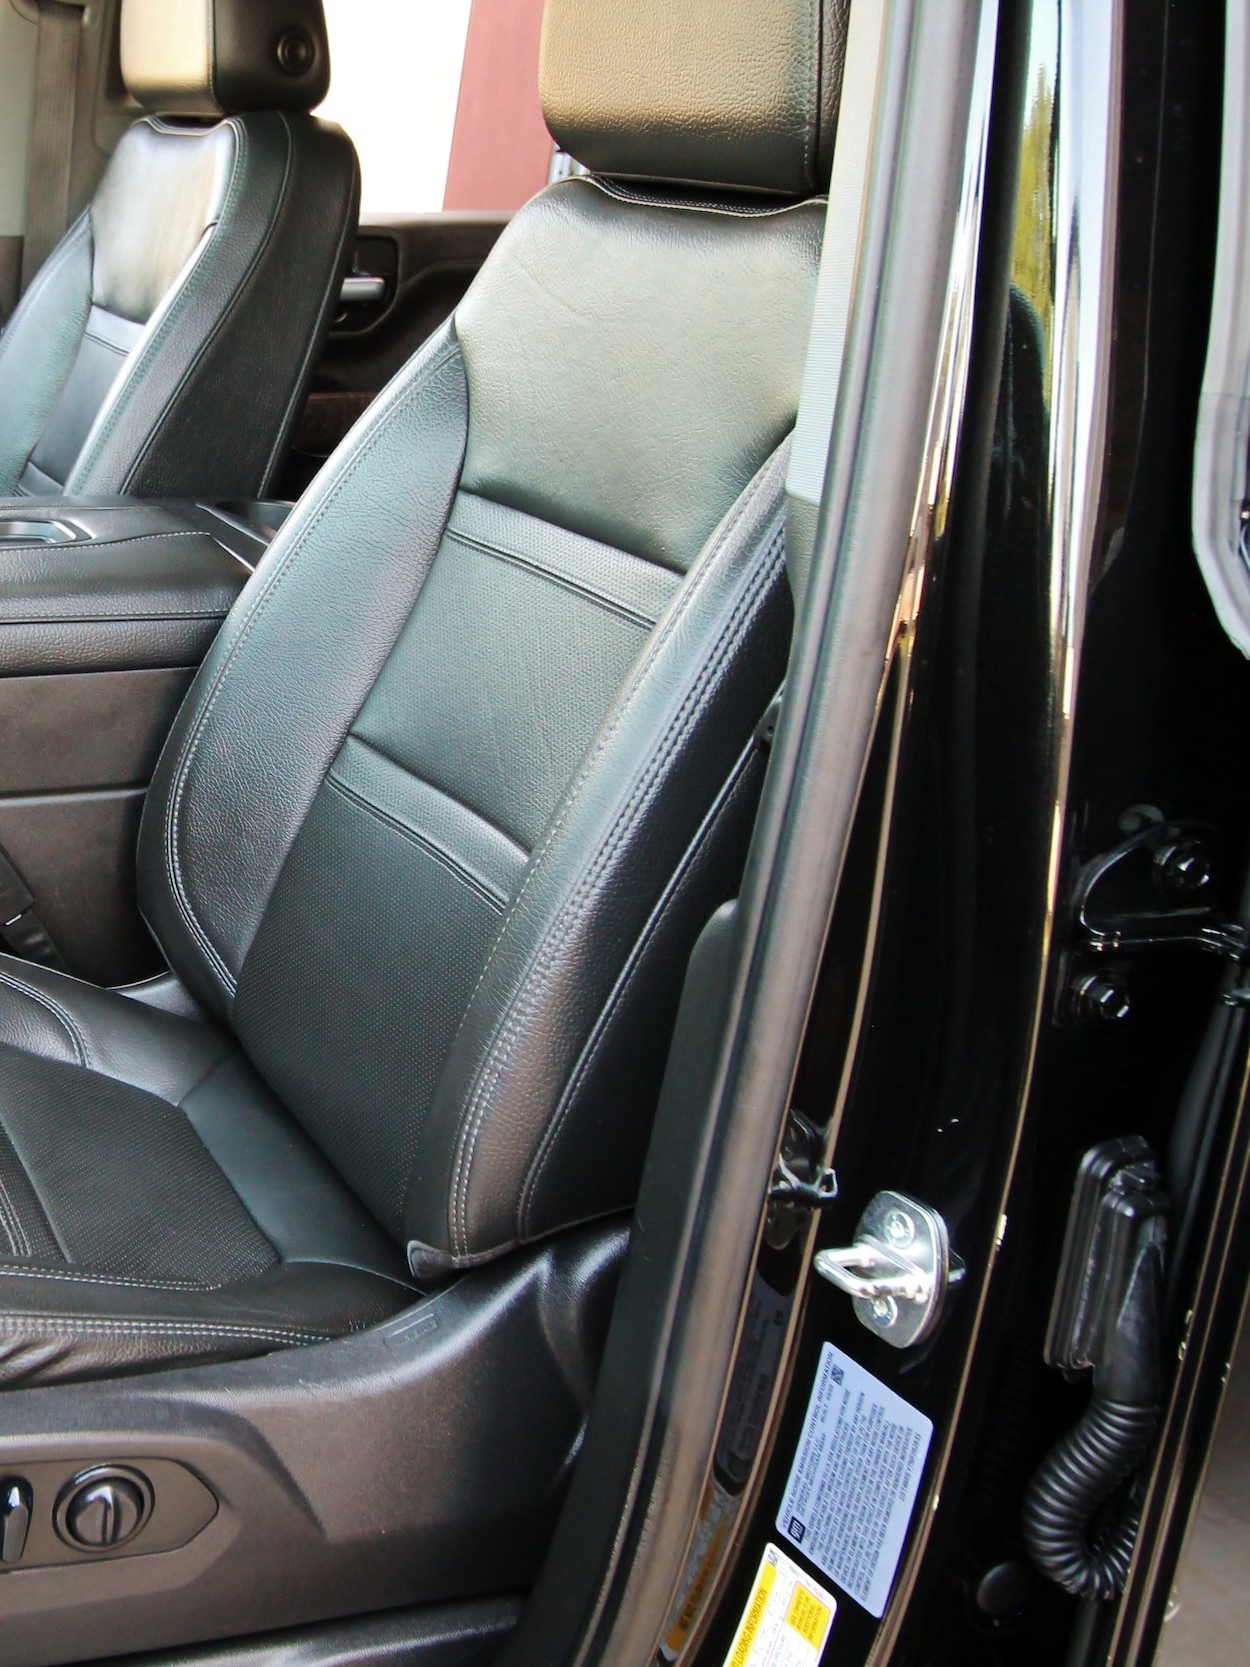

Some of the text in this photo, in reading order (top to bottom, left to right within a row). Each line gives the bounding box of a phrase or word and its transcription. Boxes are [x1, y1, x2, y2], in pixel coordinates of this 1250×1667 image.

[780, 1350, 834, 1530] VEHICLE NOISE EMISSION CONTROL INFORMATION
[795, 1480, 808, 1514] GENERAL
[803, 1449, 816, 1482] MOTORS
[789, 1518, 804, 1541] gm
[731, 1584, 768, 1666] LOADING INFORMATION
